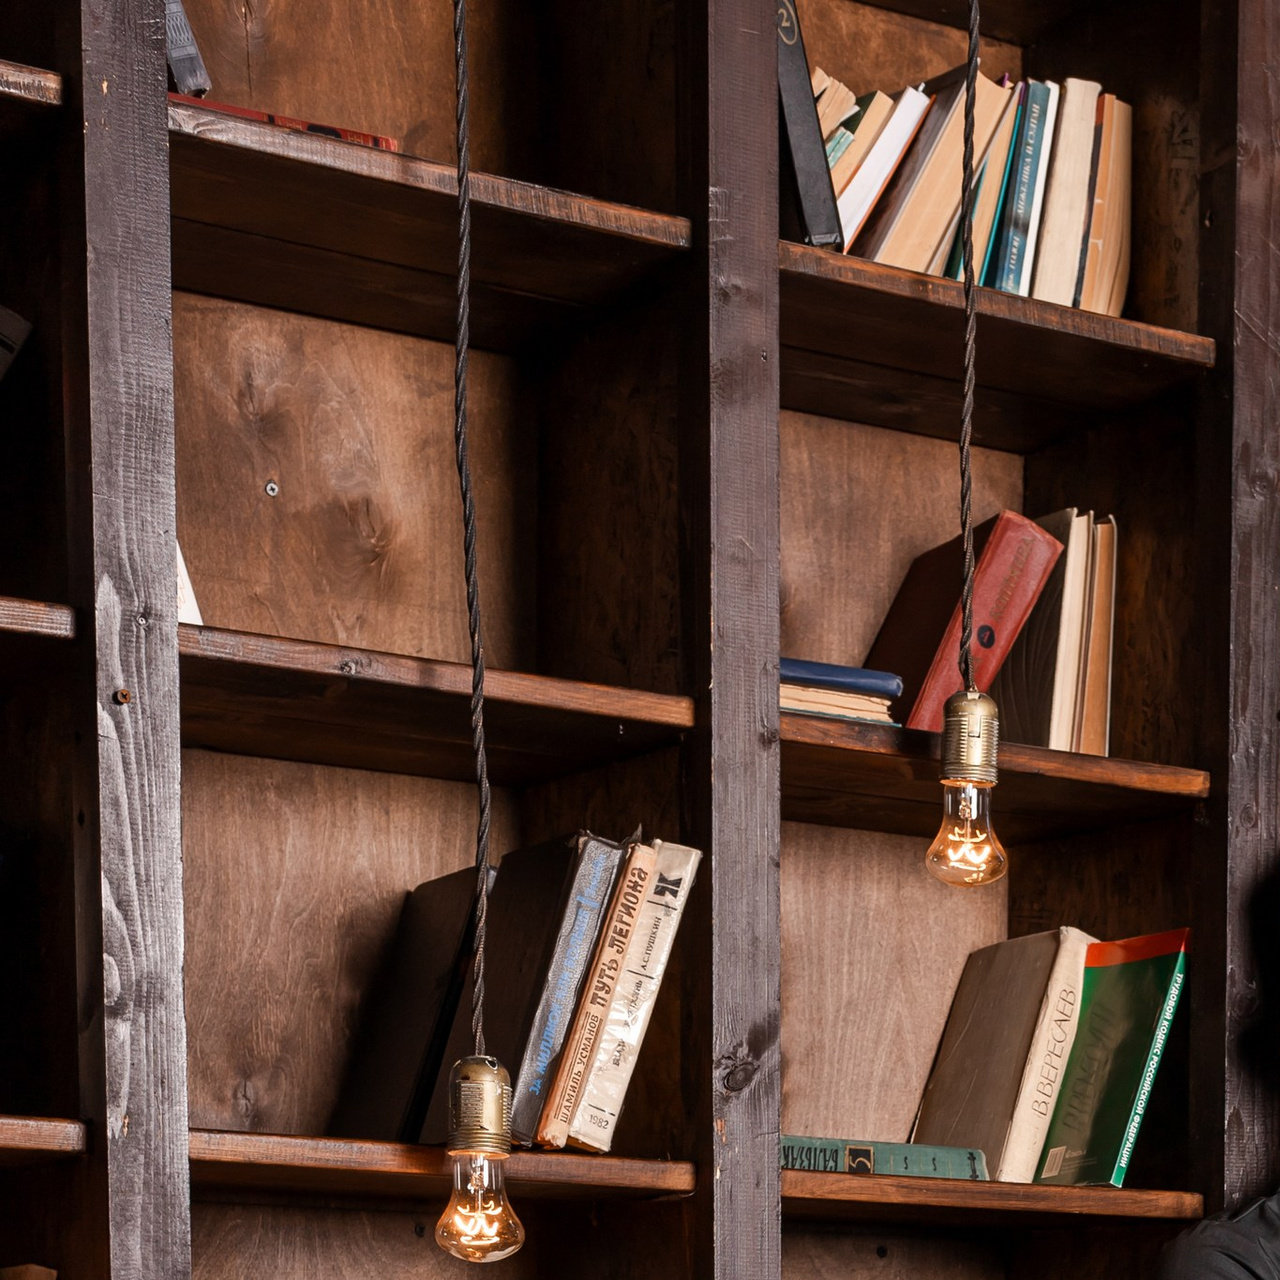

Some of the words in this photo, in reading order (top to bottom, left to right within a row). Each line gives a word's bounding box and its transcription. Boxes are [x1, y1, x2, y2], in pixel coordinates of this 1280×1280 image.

[589, 955, 621, 1008] ПУТЬ
[1162, 971, 1183, 1020] ТРУДОВОЙ
[1151, 1019, 1169, 1055] КОДЕКС
[528, 1077, 543, 1096] ЗА
[556, 1067, 584, 1123] ШАМИЛЬ
[575, 1013, 600, 1067] УСМАНОВ
[1133, 1054, 1158, 1114] РОССИЙСКОЙ
[589, 1113, 609, 1129] 1982
[1117, 1112, 1140, 1168] ФЕДЕРАЦИИ
[781, 1143, 840, 1173] БАЛЬЗАК
